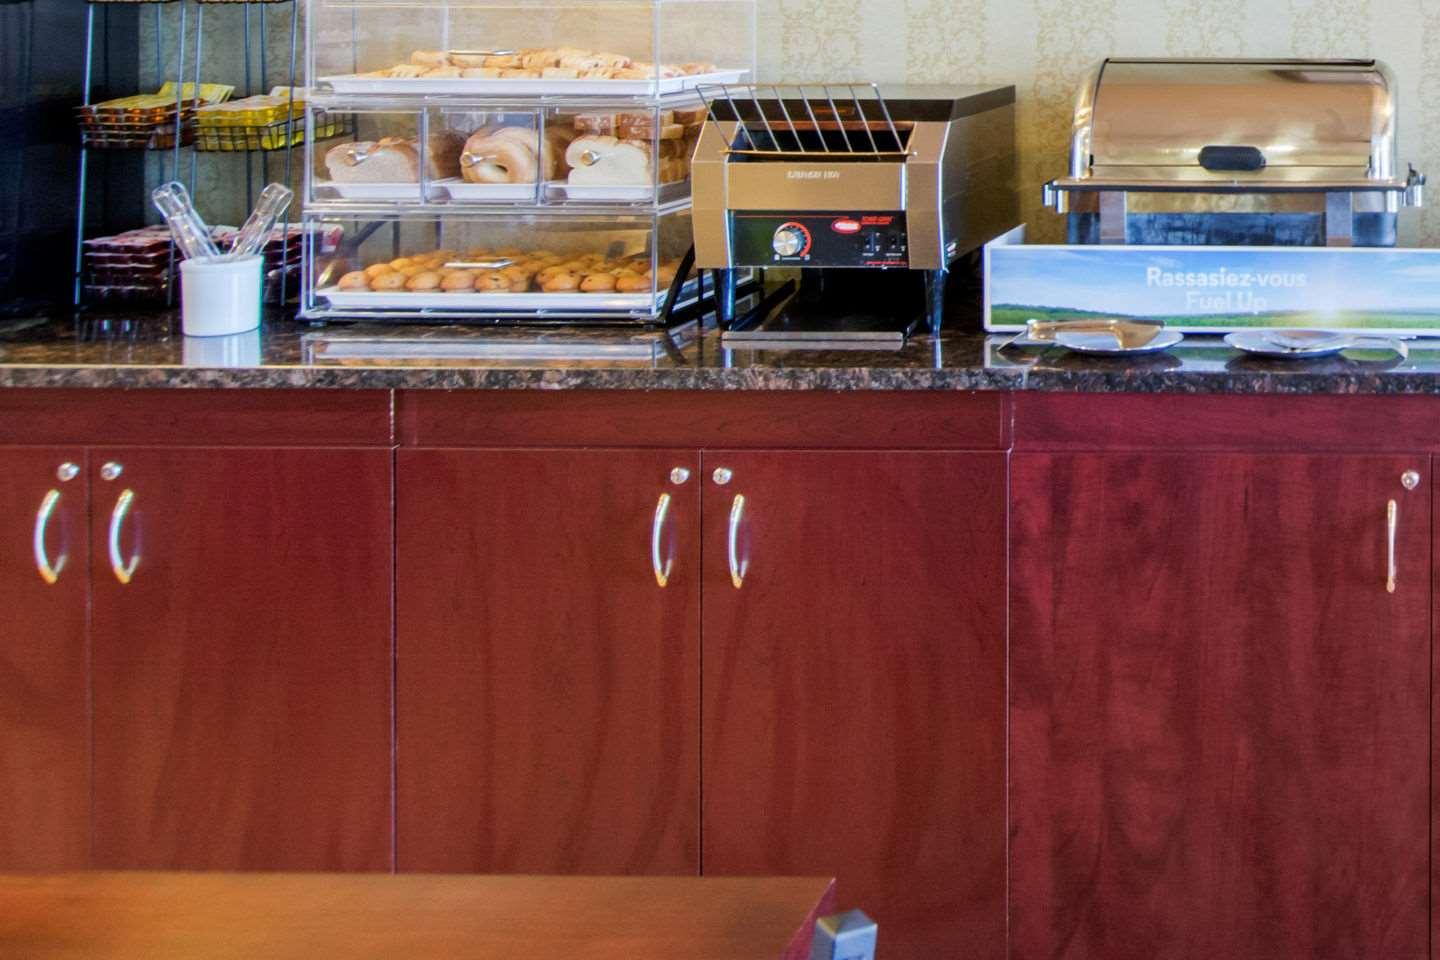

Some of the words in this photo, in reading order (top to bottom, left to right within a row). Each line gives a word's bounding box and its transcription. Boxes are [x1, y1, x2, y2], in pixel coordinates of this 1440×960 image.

[1146, 266, 1307, 287] Rassasiez-vous
[1186, 291, 1232, 310] Fuel
[1238, 291, 1267, 315] Up
